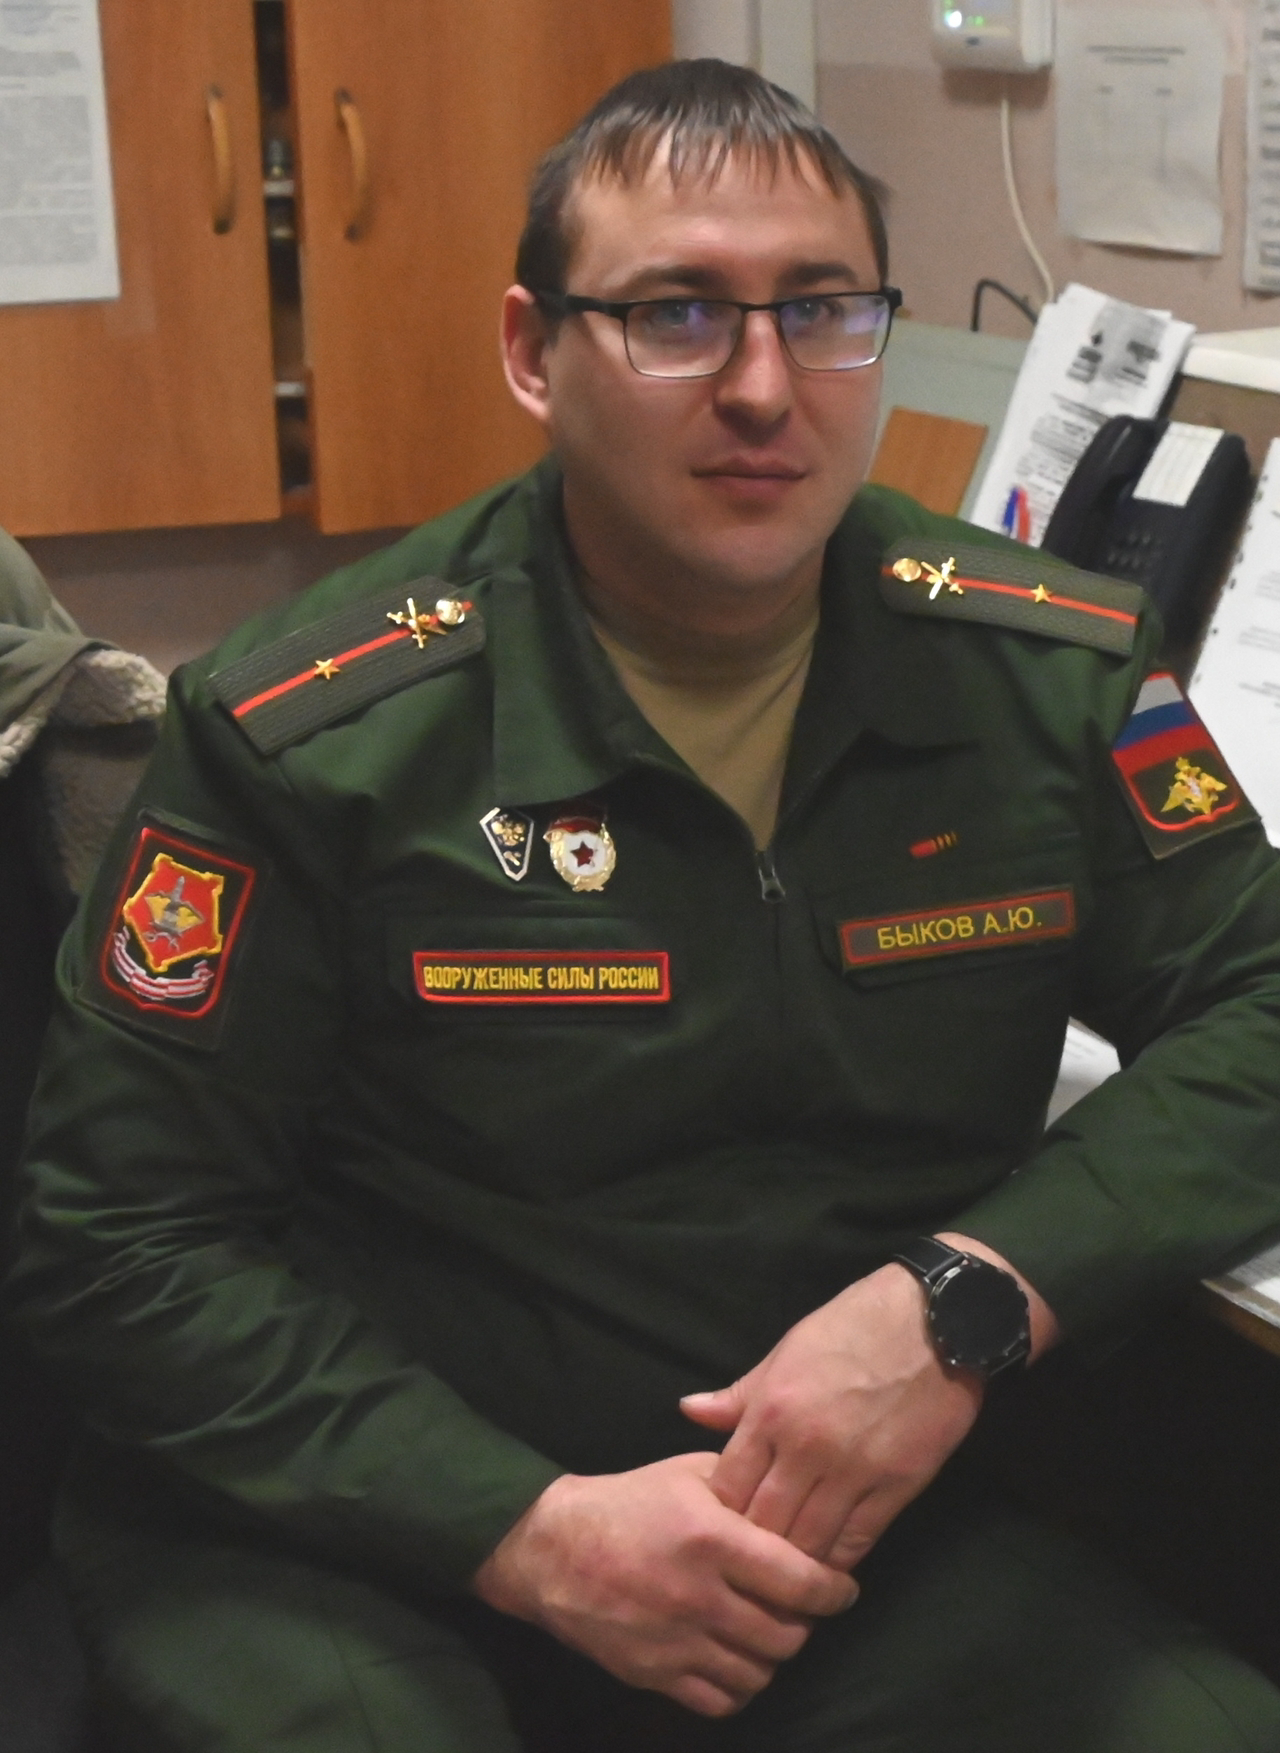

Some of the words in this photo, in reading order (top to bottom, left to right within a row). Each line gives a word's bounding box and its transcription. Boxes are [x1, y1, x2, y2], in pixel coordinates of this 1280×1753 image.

[876, 915, 974, 949] БЫКОВ
[983, 906, 1042, 935] А.Ю.
[423, 966, 544, 990] ВООРУЖЕННЫЕ
[547, 966, 594, 990] СИЛЫ
[598, 966, 659, 990] РОССИИ
